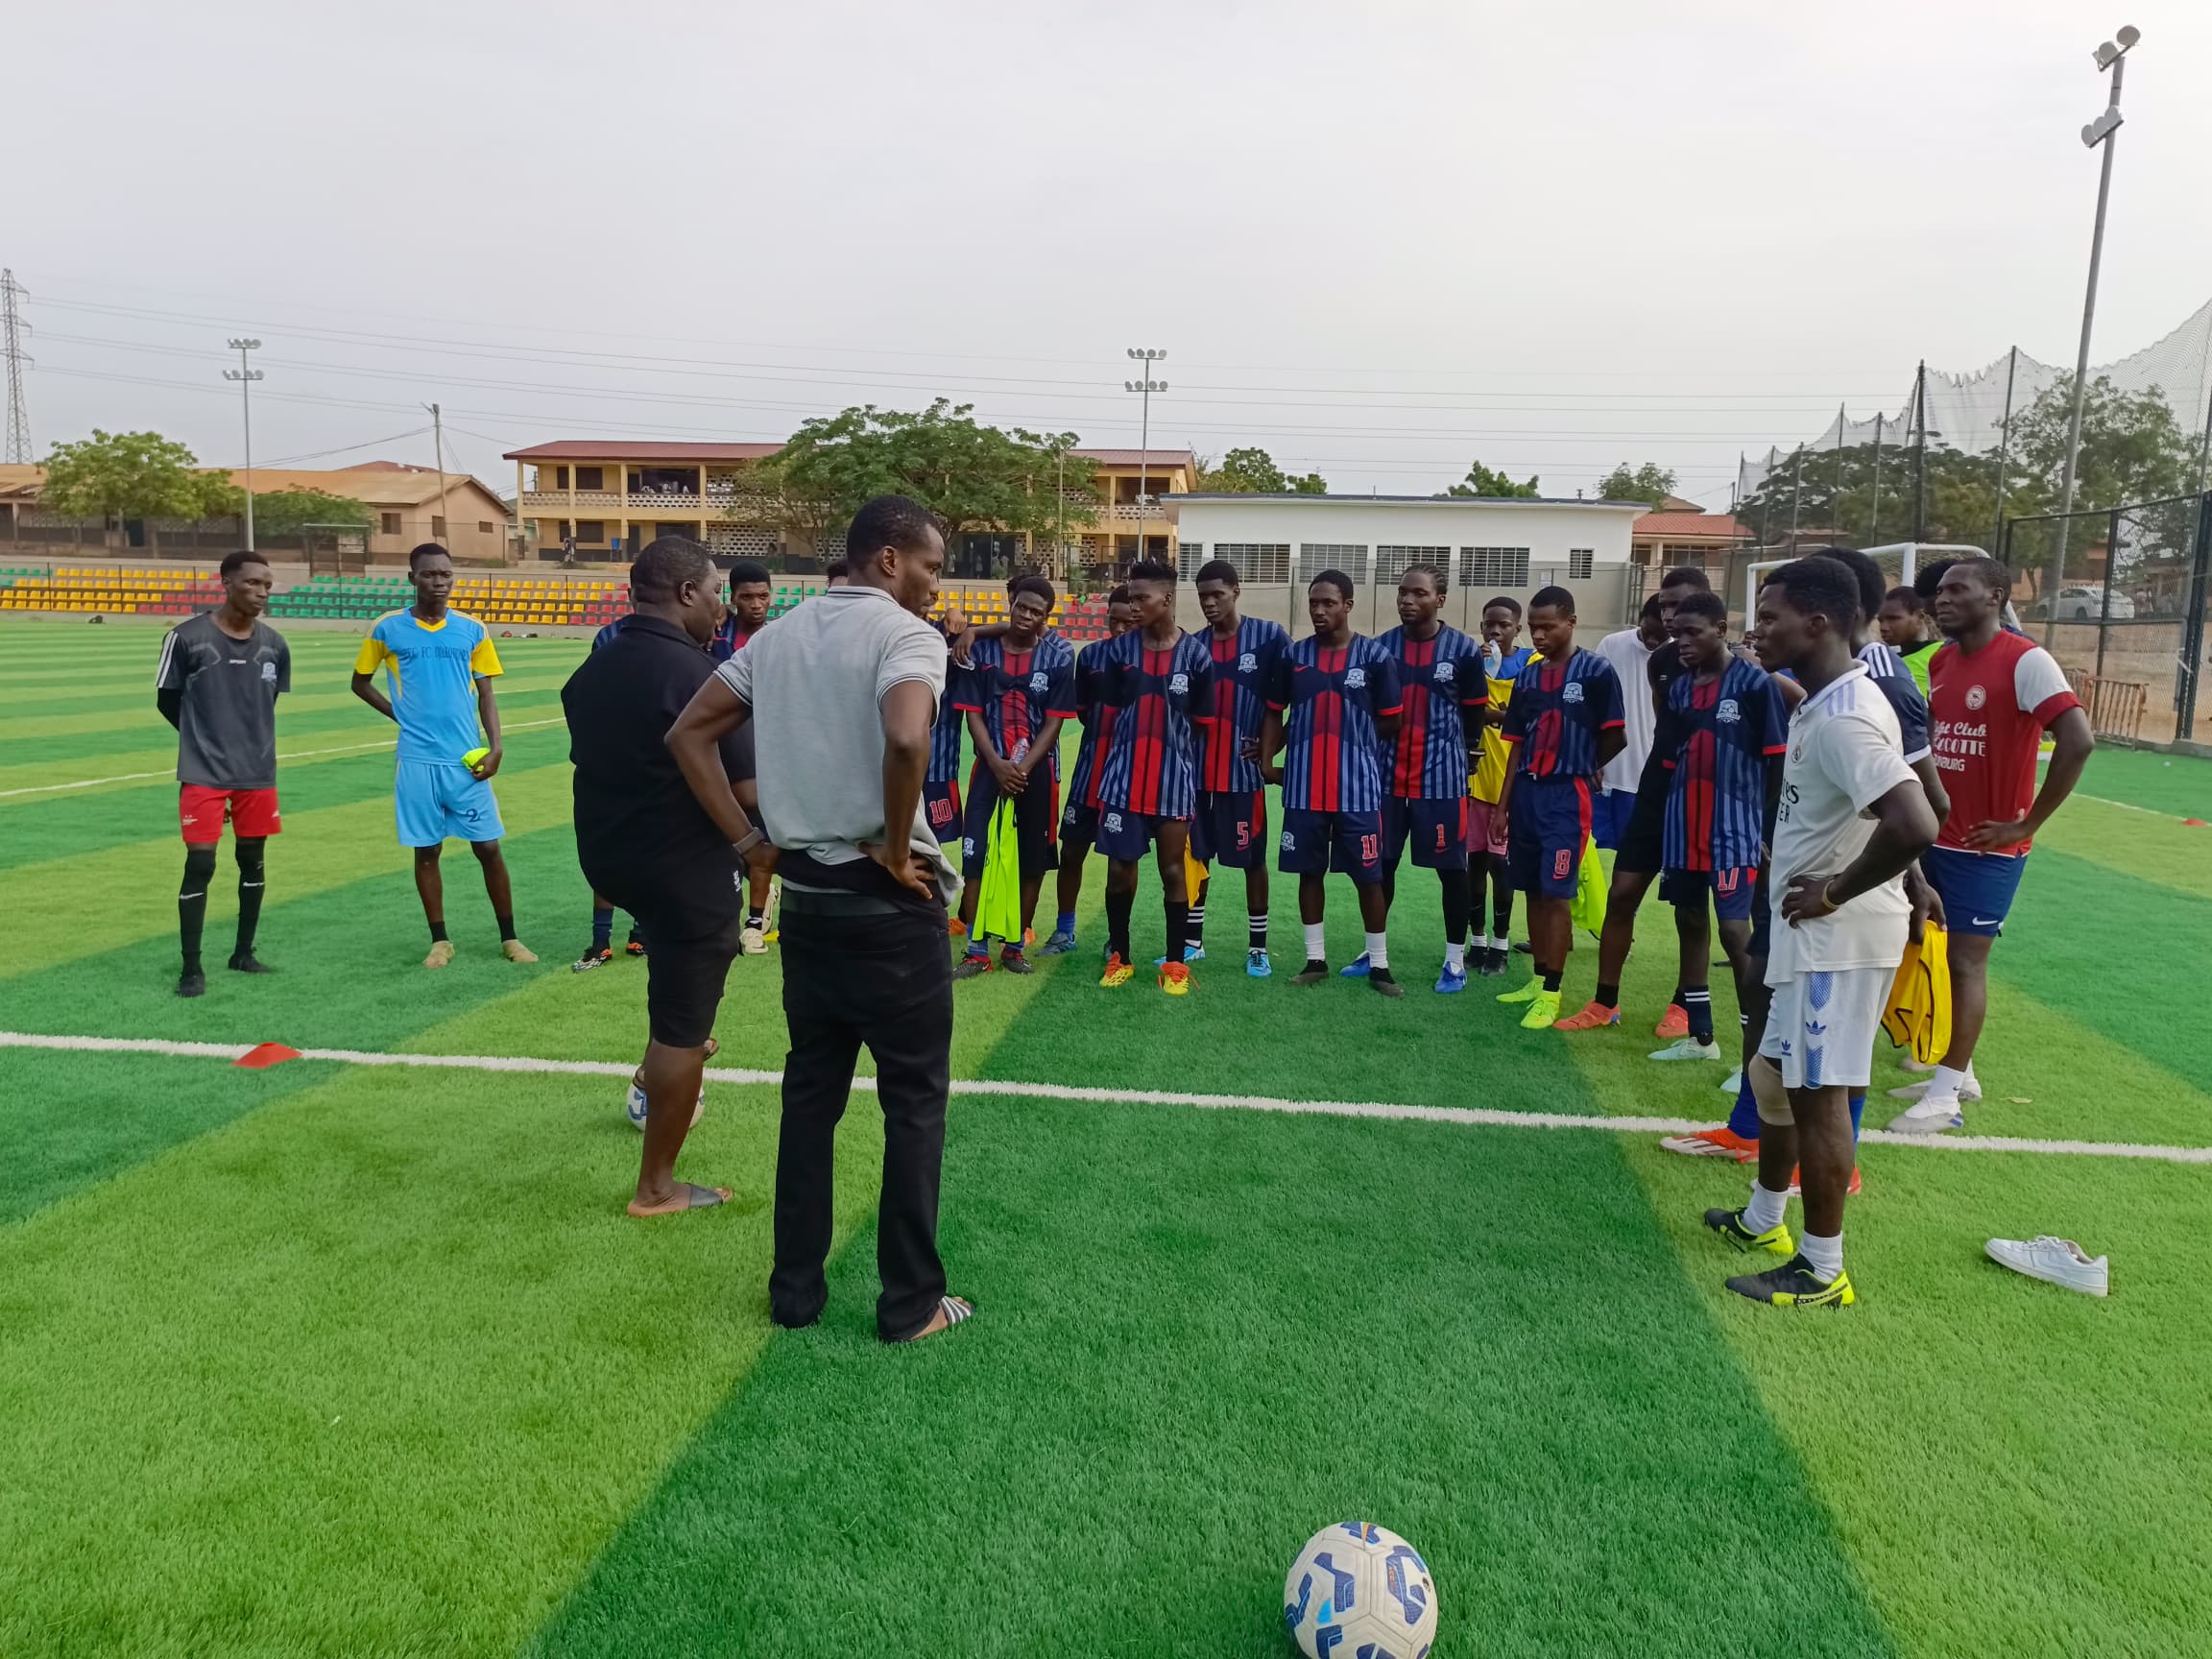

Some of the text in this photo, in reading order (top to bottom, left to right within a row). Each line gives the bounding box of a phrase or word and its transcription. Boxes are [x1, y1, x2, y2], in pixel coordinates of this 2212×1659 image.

[1953, 721, 1988, 737] Club
[466, 807, 481, 823] 2
[929, 798, 953, 824] 10
[1237, 821, 1249, 846] 5
[1435, 823, 1446, 847] 1
[1360, 833, 1379, 860] 11
[1554, 849, 1572, 876] 8
